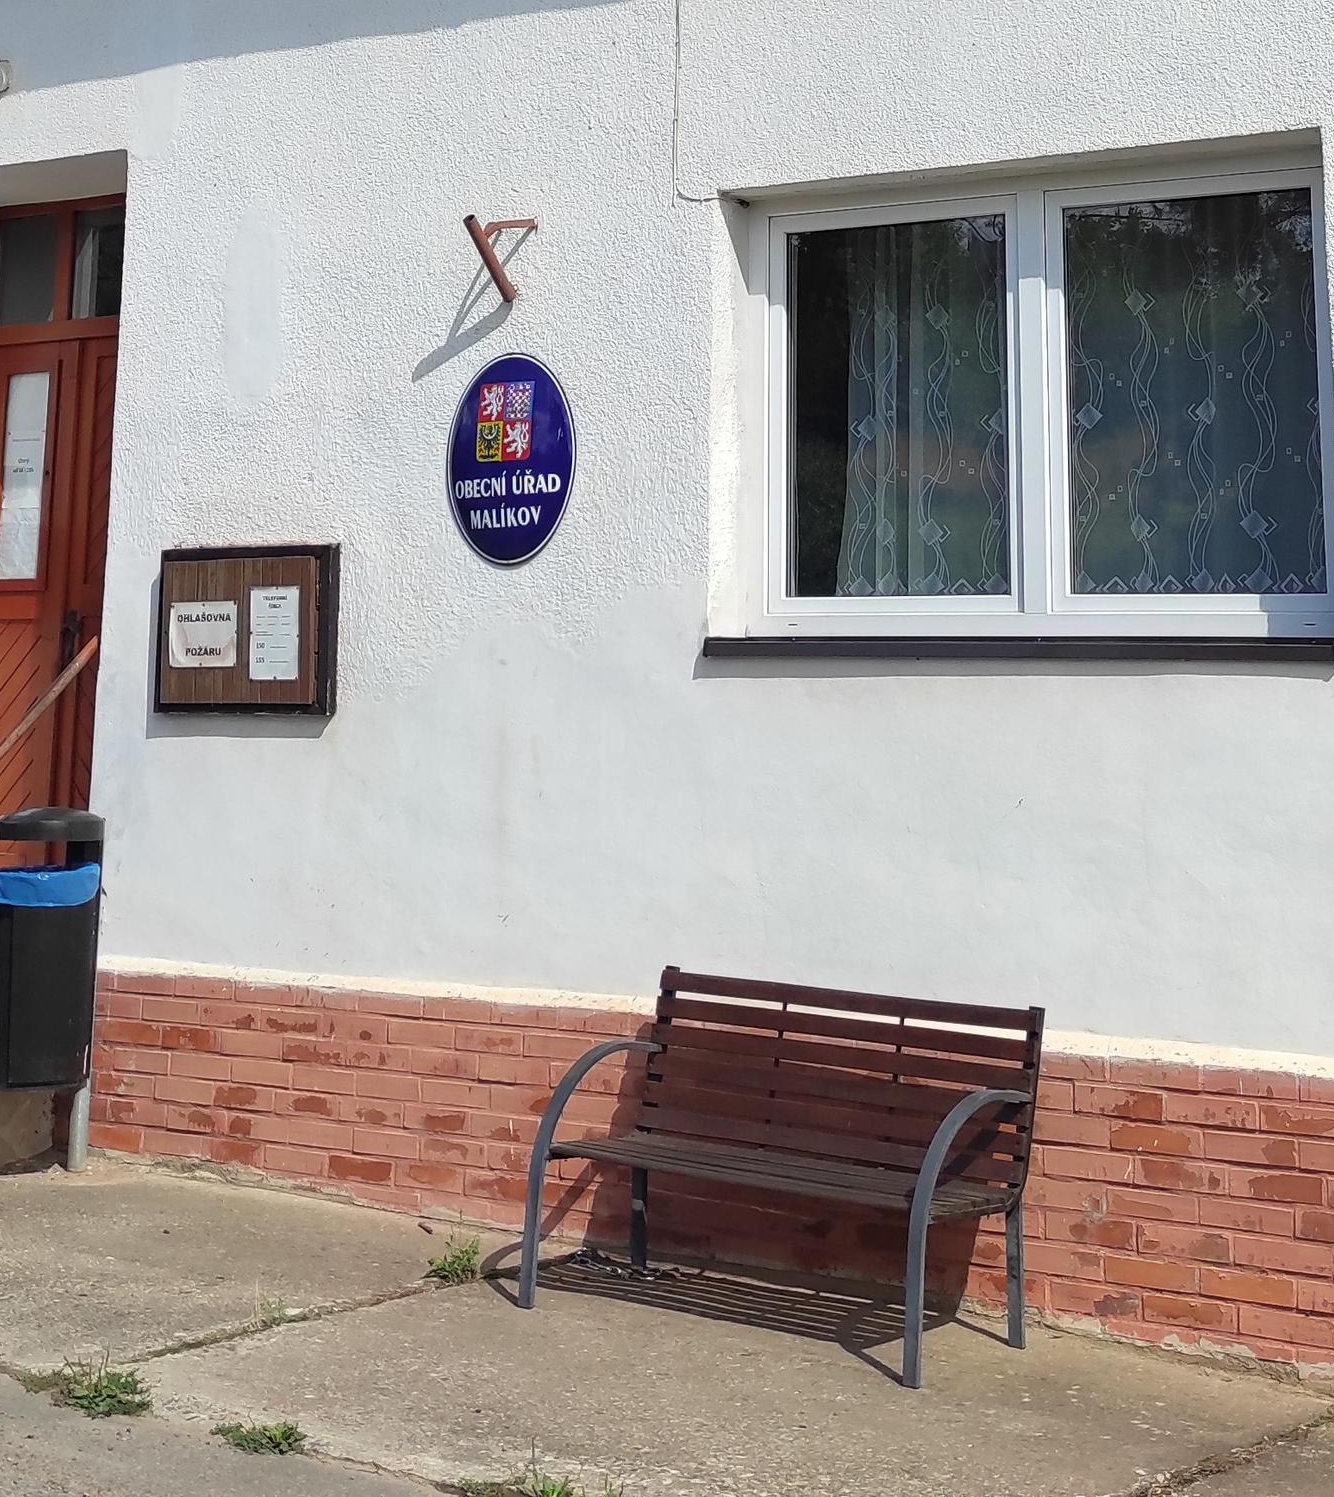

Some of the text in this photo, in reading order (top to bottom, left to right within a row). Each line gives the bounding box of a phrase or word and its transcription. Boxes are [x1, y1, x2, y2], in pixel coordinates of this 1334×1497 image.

[455, 469, 561, 499] OBECNÍ ÚŘAD
[470, 502, 541, 529] MALÍKOV
[177, 612, 231, 623] OHLAŠOVNA
